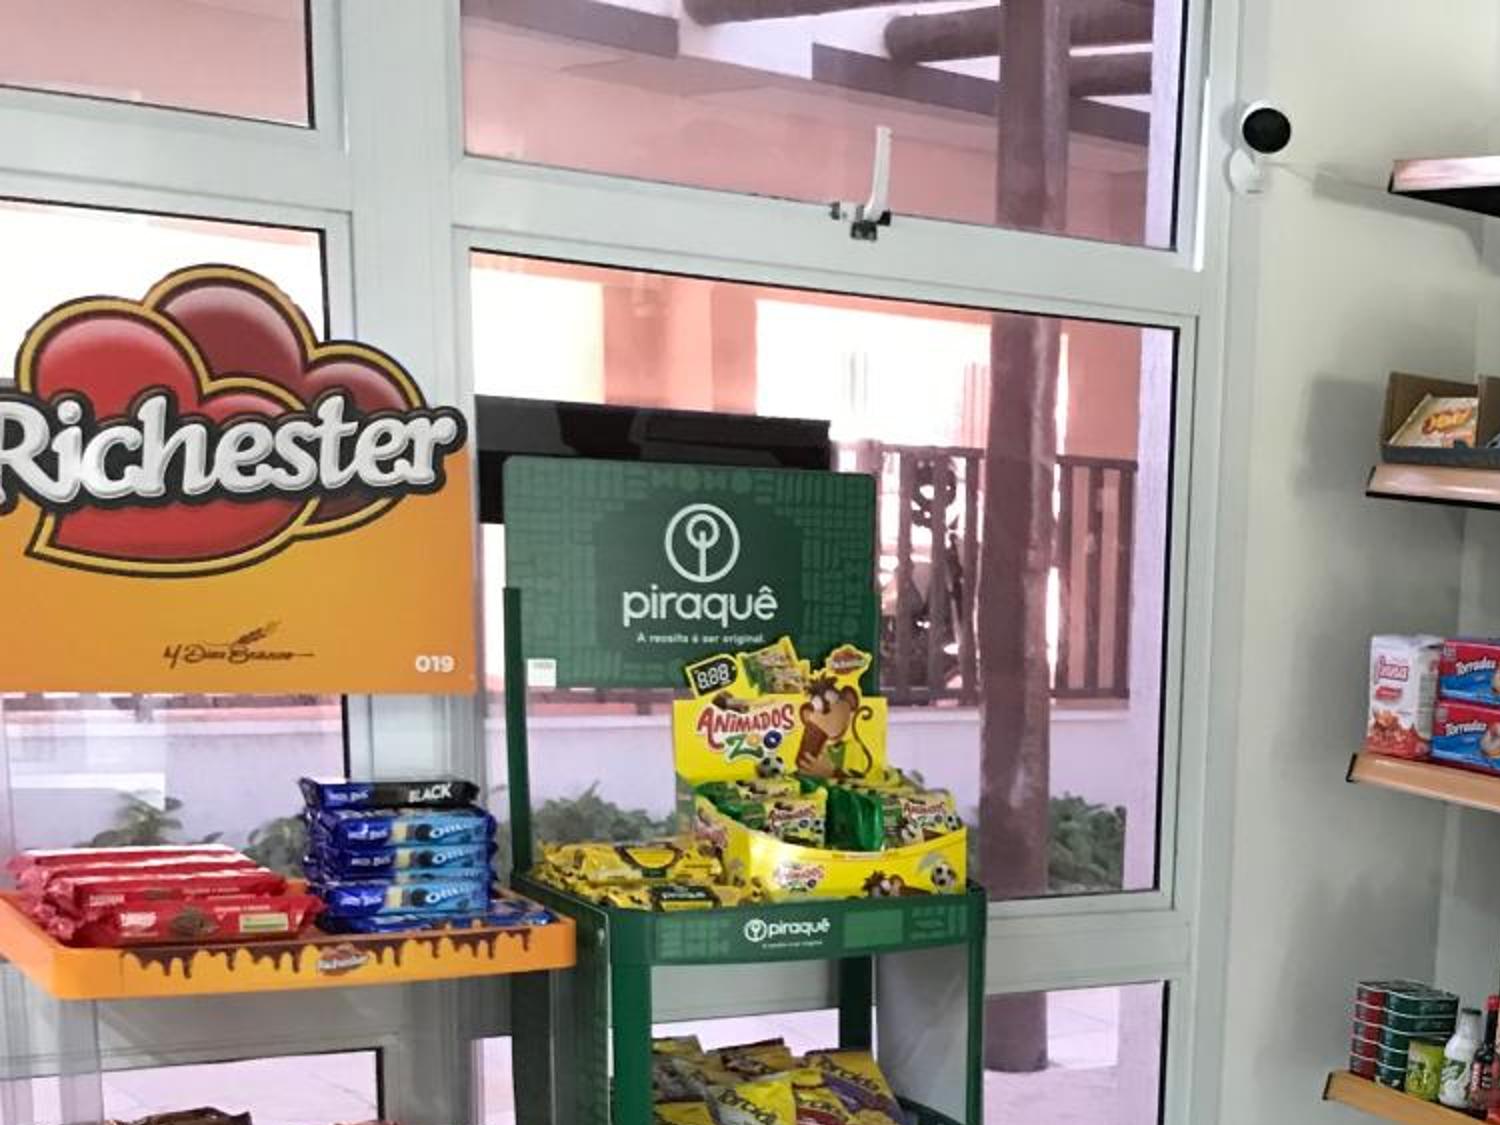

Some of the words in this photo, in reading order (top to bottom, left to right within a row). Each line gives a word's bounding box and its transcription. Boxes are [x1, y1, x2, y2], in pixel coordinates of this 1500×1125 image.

[0, 395, 457, 502] Richester
[623, 584, 778, 628] piraquê
[415, 655, 454, 672] 019
[409, 783, 453, 804] BLACK
[769, 917, 831, 939] piraquê
